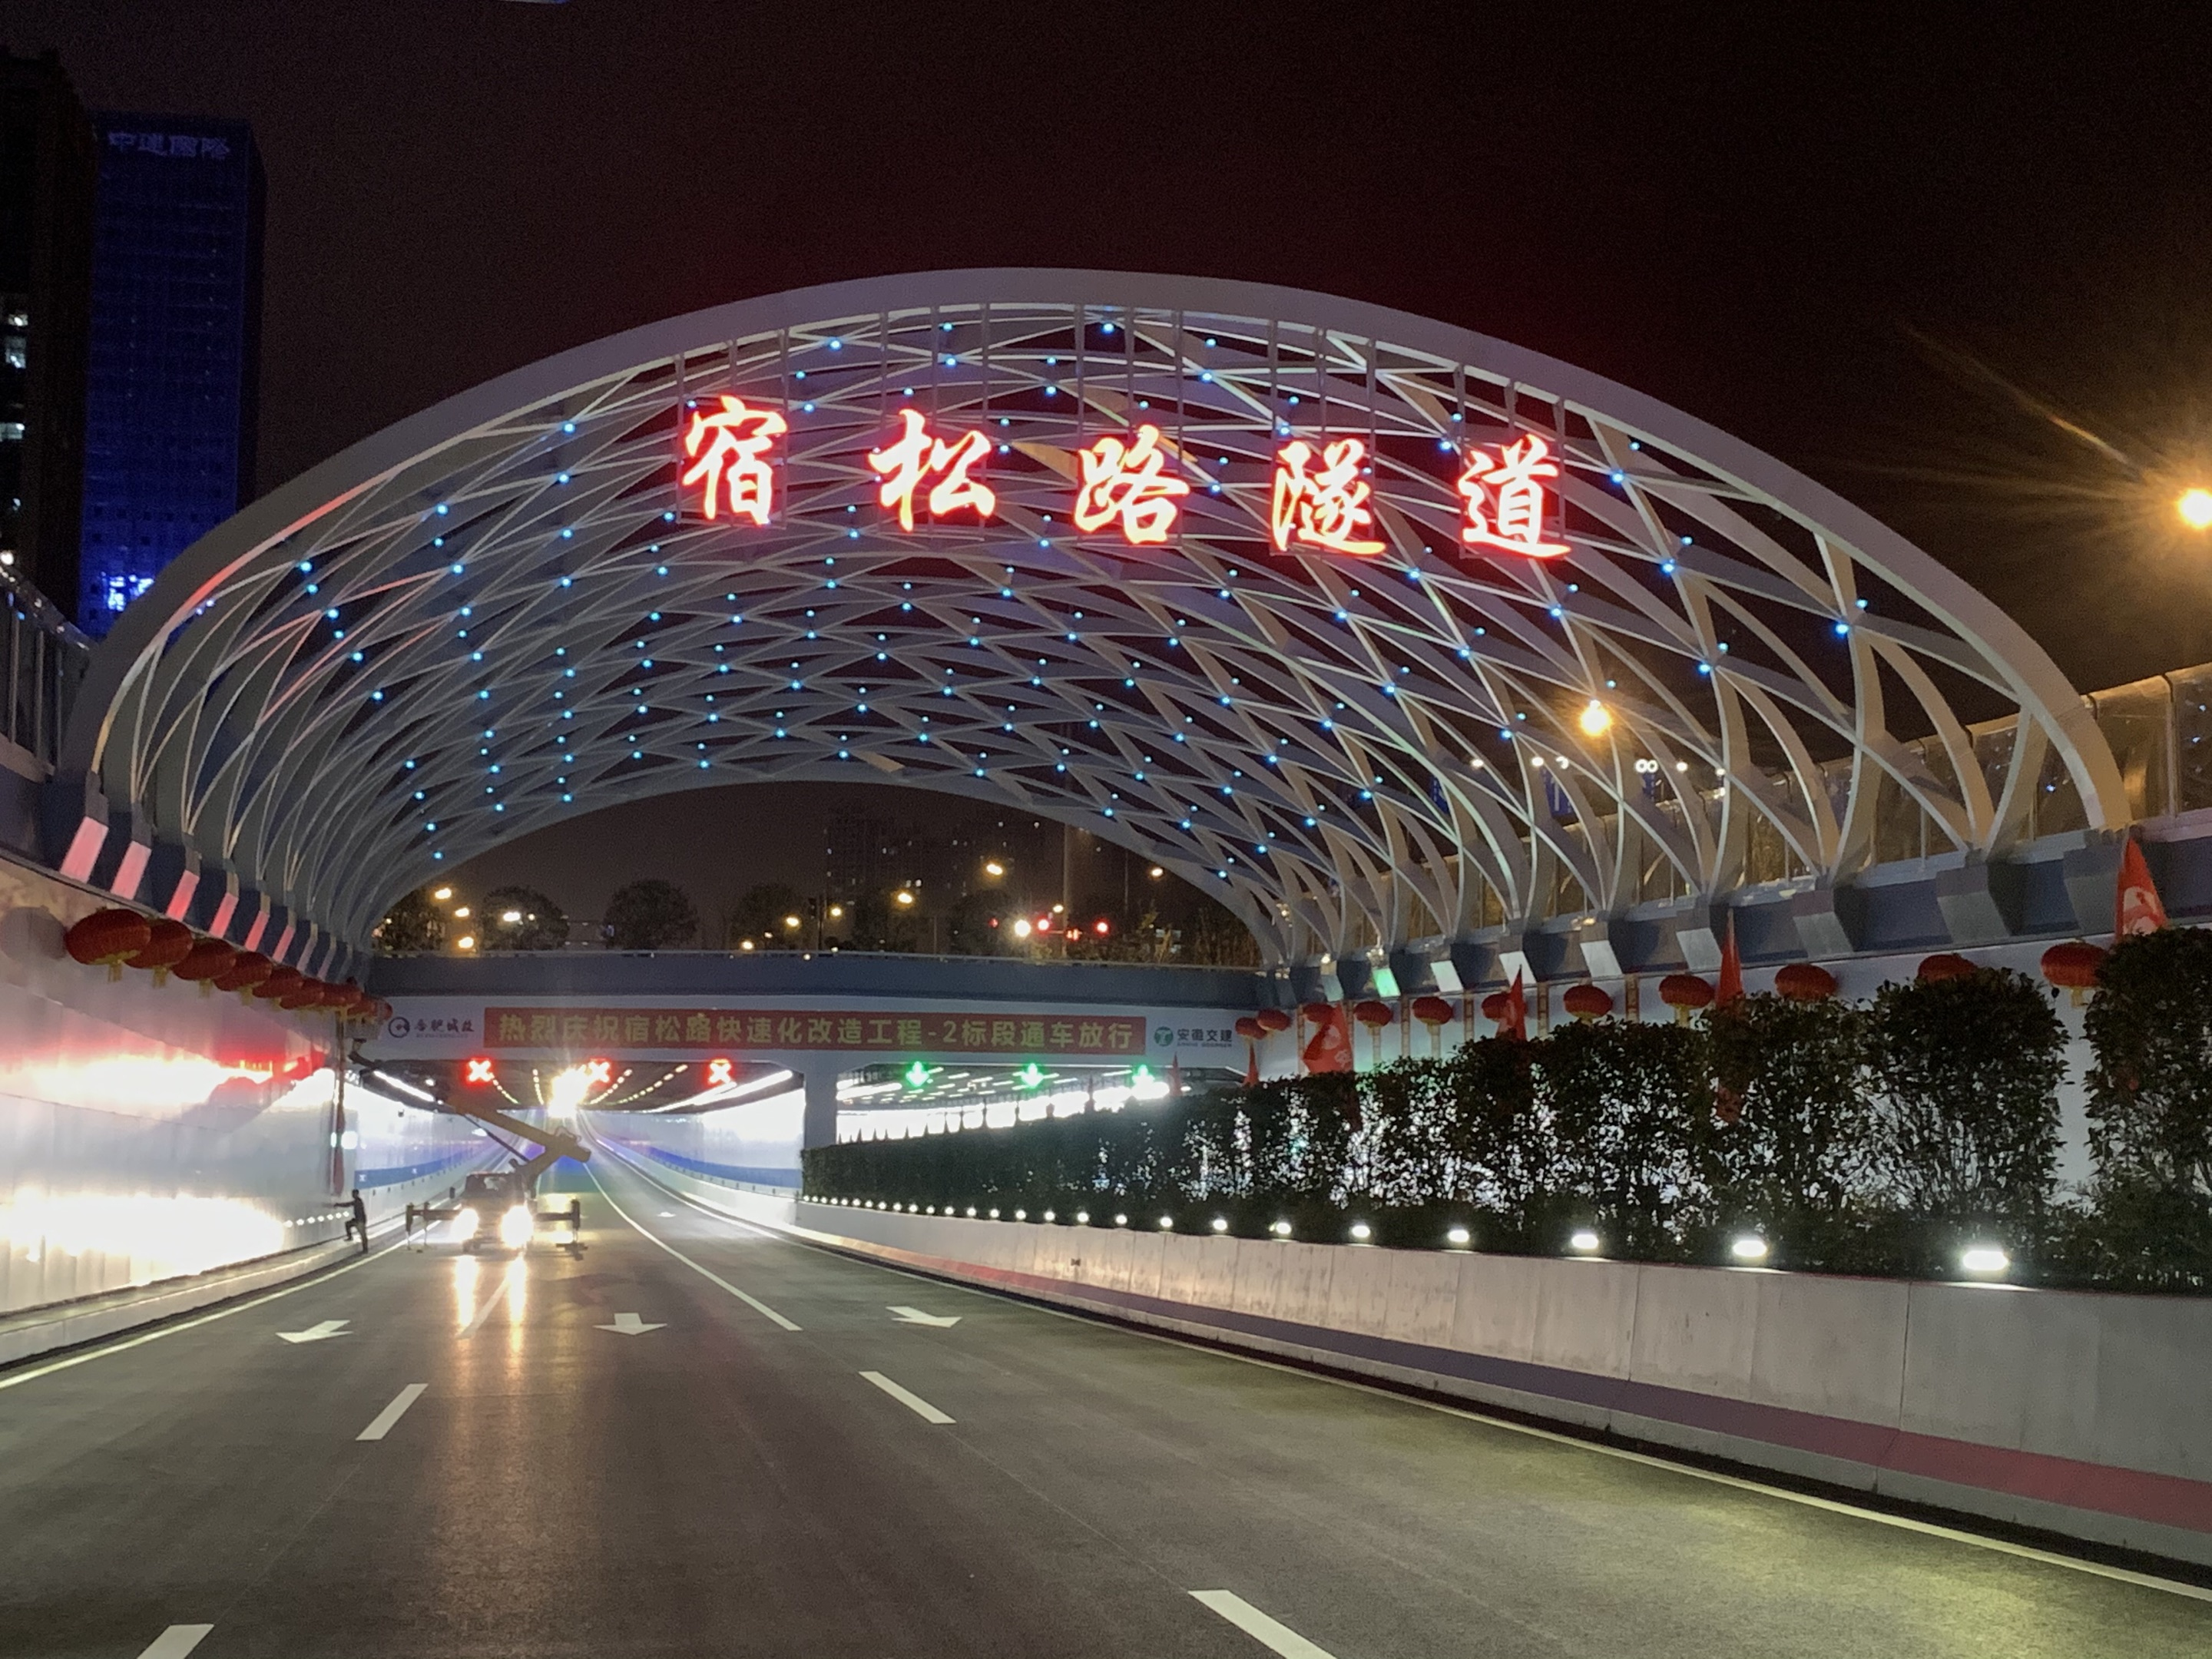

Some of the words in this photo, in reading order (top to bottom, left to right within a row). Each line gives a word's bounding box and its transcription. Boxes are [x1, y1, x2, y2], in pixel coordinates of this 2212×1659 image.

[683, 395, 1571, 558] 宿松路隧道
[499, 1012, 1133, 1049] 热烈庆祝宿松路快速化改造工程-2标段通车放行
[1177, 1028, 1233, 1042] 安徽交建
